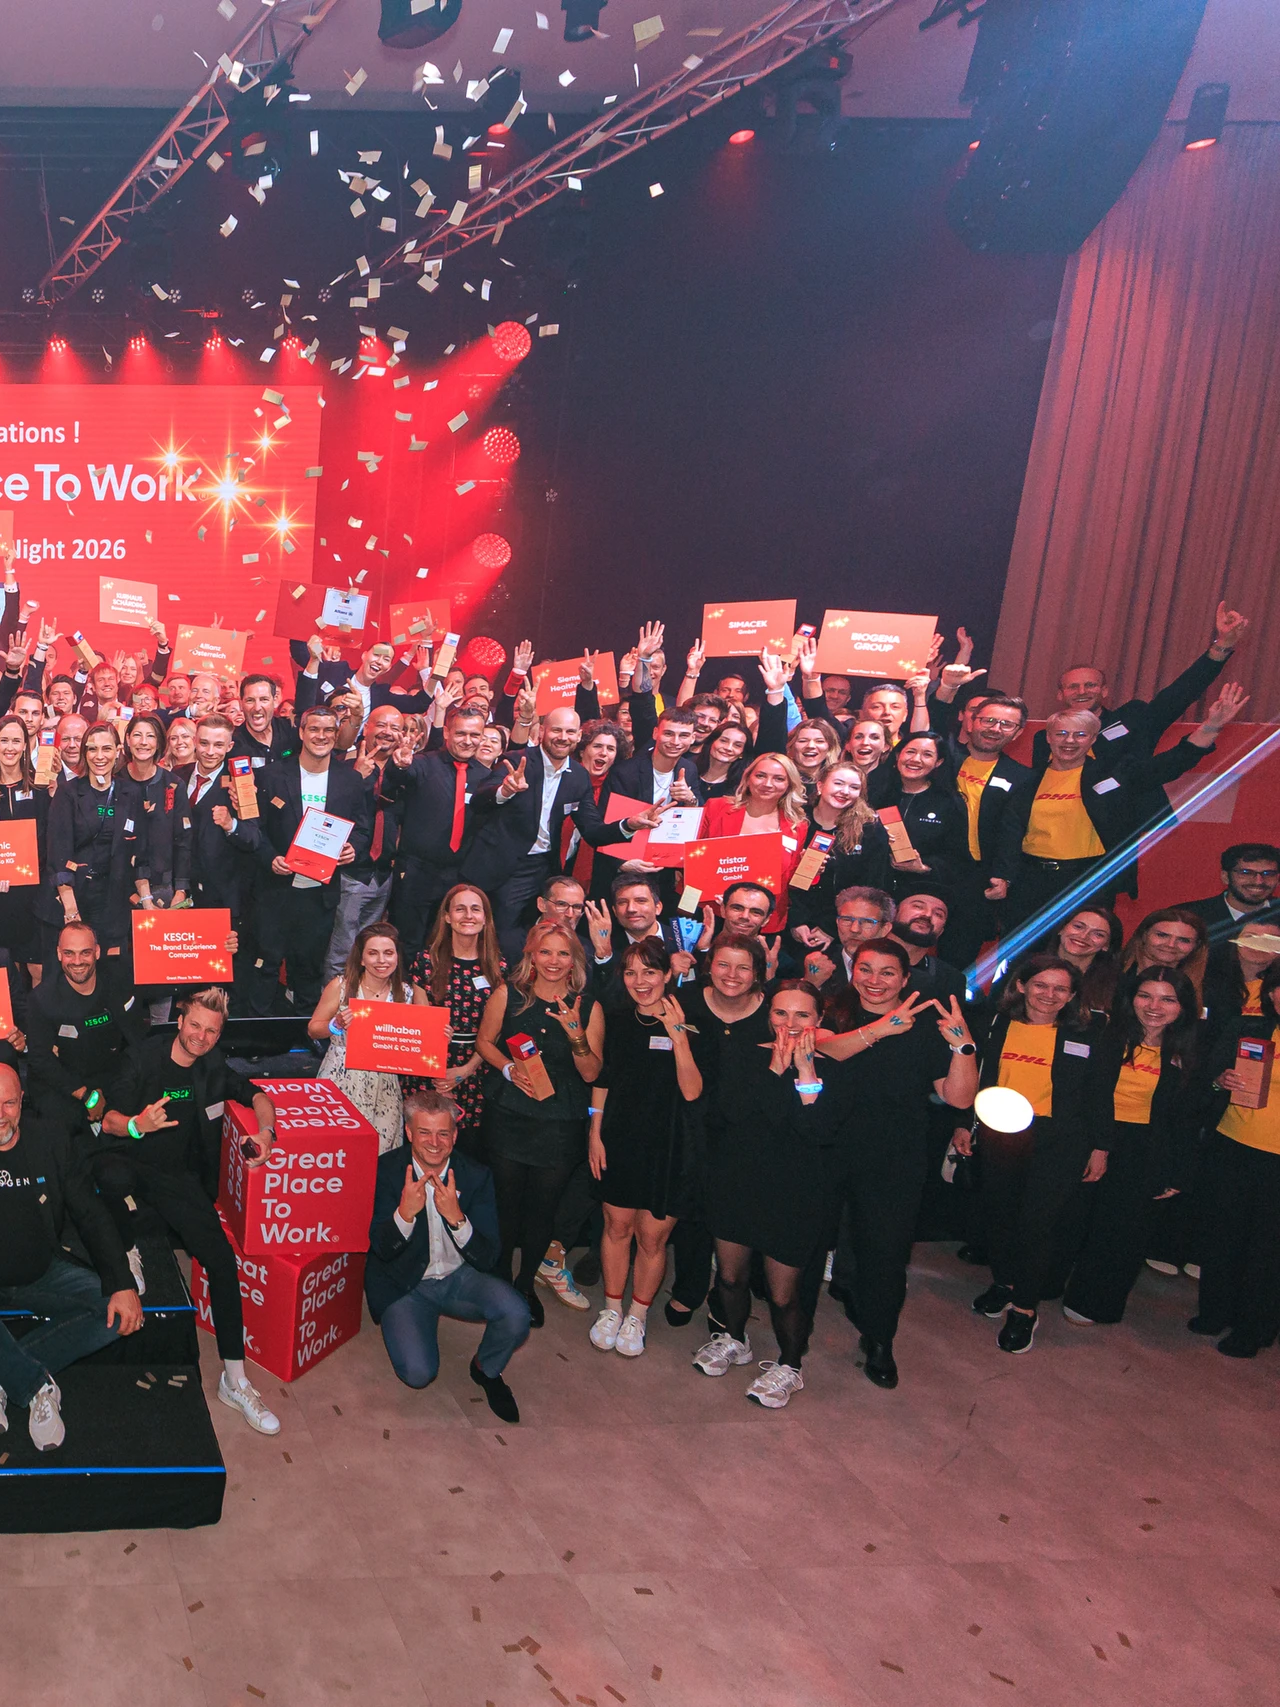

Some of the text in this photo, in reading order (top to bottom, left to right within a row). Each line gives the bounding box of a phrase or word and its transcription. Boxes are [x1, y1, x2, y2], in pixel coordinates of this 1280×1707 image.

[34, 464, 82, 502] To
[71, 538, 127, 560] 2026
[728, 620, 768, 629] SIMACEK
[851, 632, 900, 644] BIOGENA
[853, 641, 894, 652] GROUP
[1037, 793, 1077, 801] DHL
[719, 855, 747, 865] tristar
[716, 864, 749, 875] Austria
[163, 933, 195, 942] KESCH
[182, 943, 217, 952] Experience
[168, 951, 200, 959] Company
[374, 1024, 421, 1036] willhaben
[372, 1034, 422, 1045] internet service
[372, 1042, 393, 1051] GmbH
[1001, 1052, 1048, 1066] DHL
[309, 1094, 343, 1105] To
[275, 1106, 350, 1117] Place
[280, 1118, 361, 1130] Great
[265, 1147, 347, 1170] Great
[264, 1173, 343, 1194] Place
[261, 1198, 292, 1219] To
[302, 1252, 349, 1296] Great
[301, 1277, 346, 1321] Place
[299, 1320, 317, 1343] To
